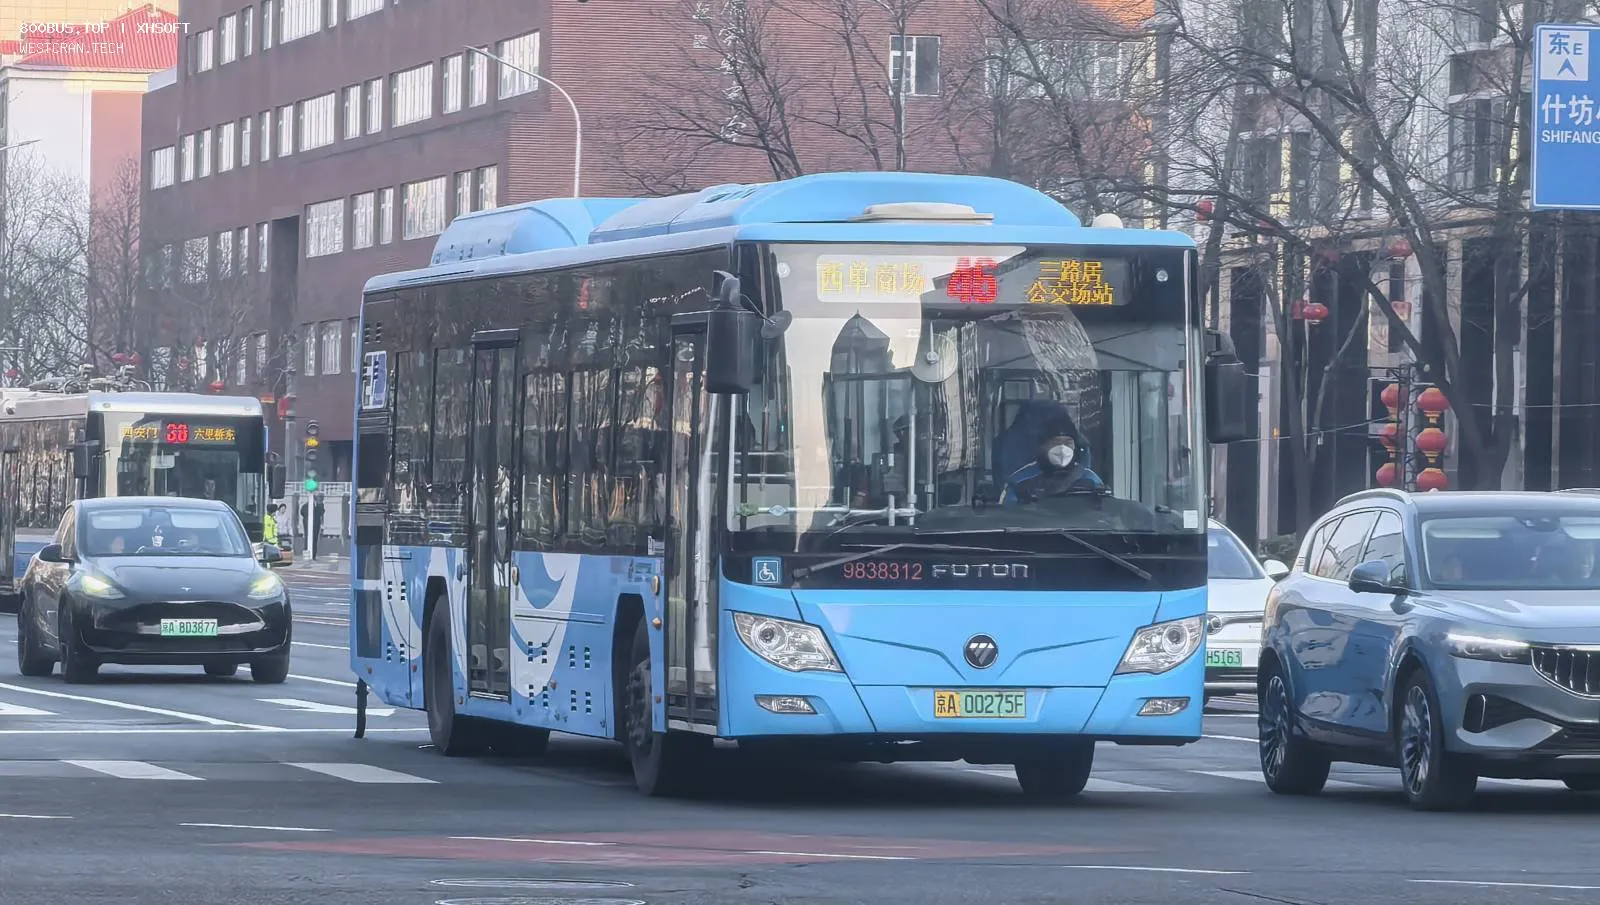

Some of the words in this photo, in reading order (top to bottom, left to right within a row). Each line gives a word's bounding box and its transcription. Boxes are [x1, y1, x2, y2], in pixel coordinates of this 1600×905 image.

[1549, 33, 1570, 55] 东
[1574, 43, 1584, 55] E
[816, 260, 925, 297] 西单商场
[947, 256, 1000, 304] 46
[1038, 260, 1105, 283] 三路居
[1026, 280, 1114, 305] 公交场站
[843, 562, 923, 580] 9838312
[936, 694, 957, 714] 京A
[964, 694, 1024, 714] 00275F
